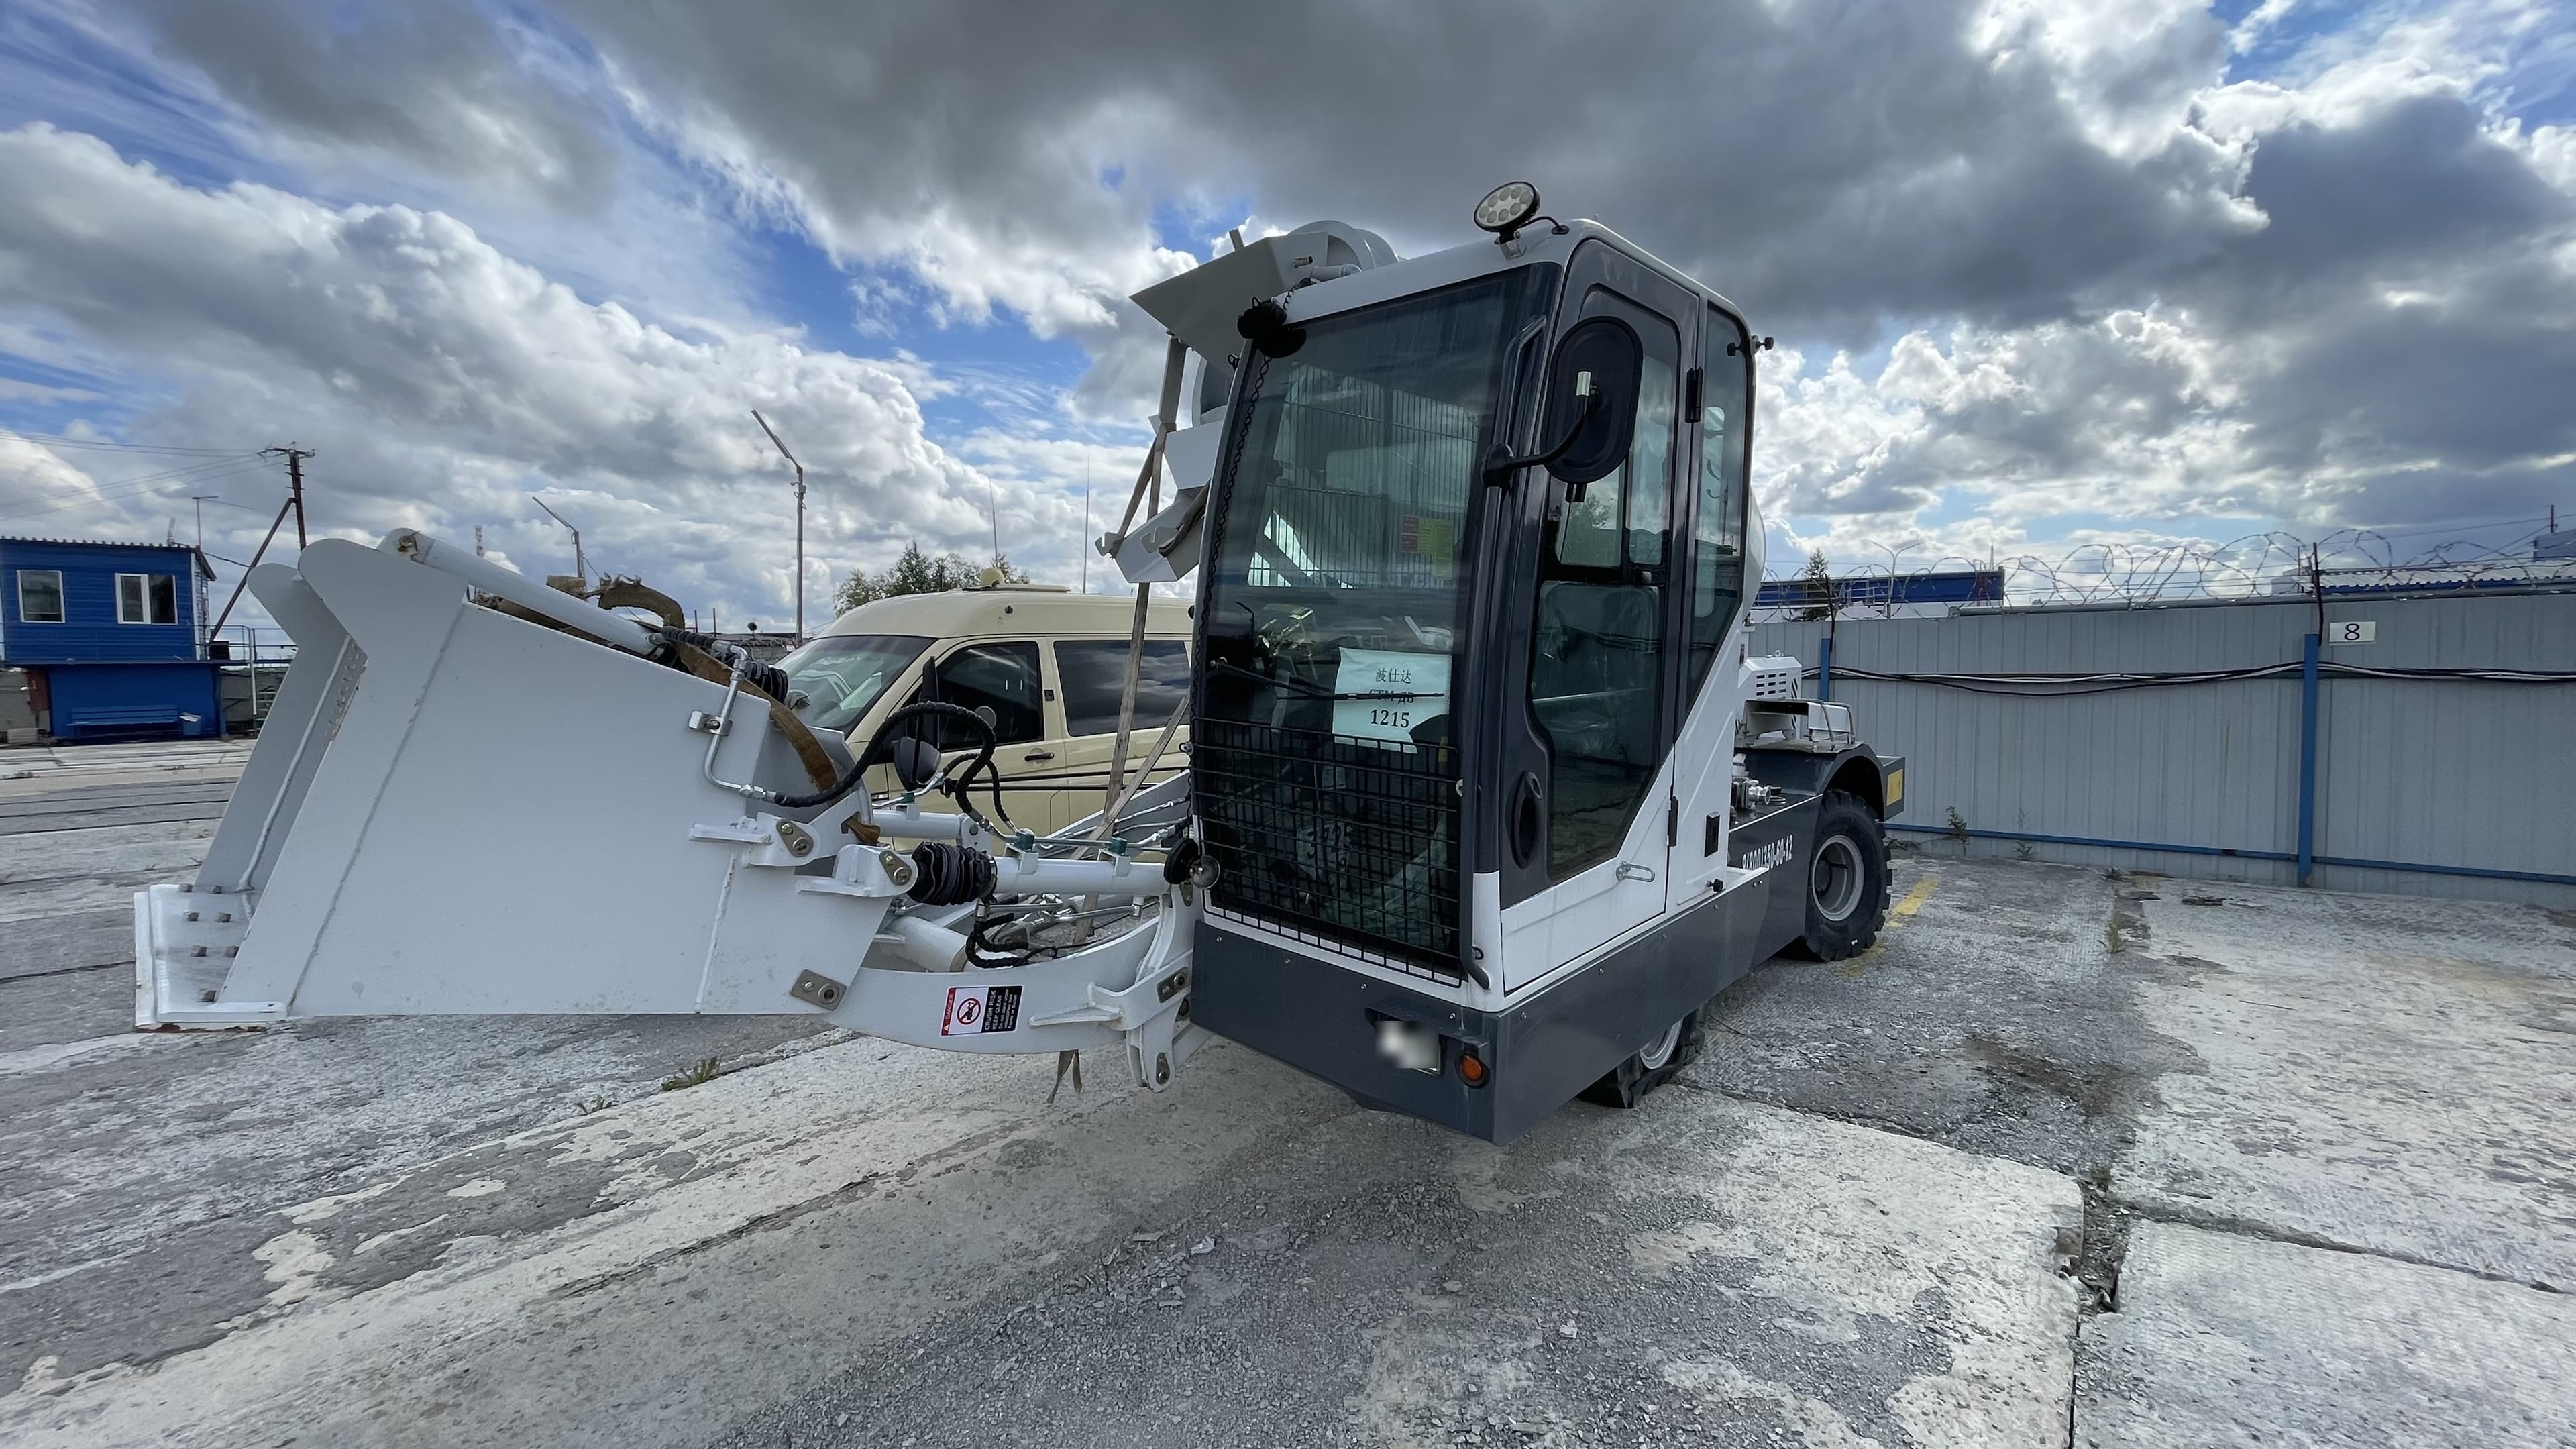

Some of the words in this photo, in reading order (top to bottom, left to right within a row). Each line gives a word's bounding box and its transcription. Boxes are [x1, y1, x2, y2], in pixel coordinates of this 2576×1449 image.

[2344, 623, 2360, 641] 8
[1375, 667, 1411, 684] 波仕达
[1371, 709, 1409, 728] 1215
[945, 994, 954, 1020] DANGER
[984, 1008, 994, 1030] CRUSH
[989, 990, 997, 1006] RISK
